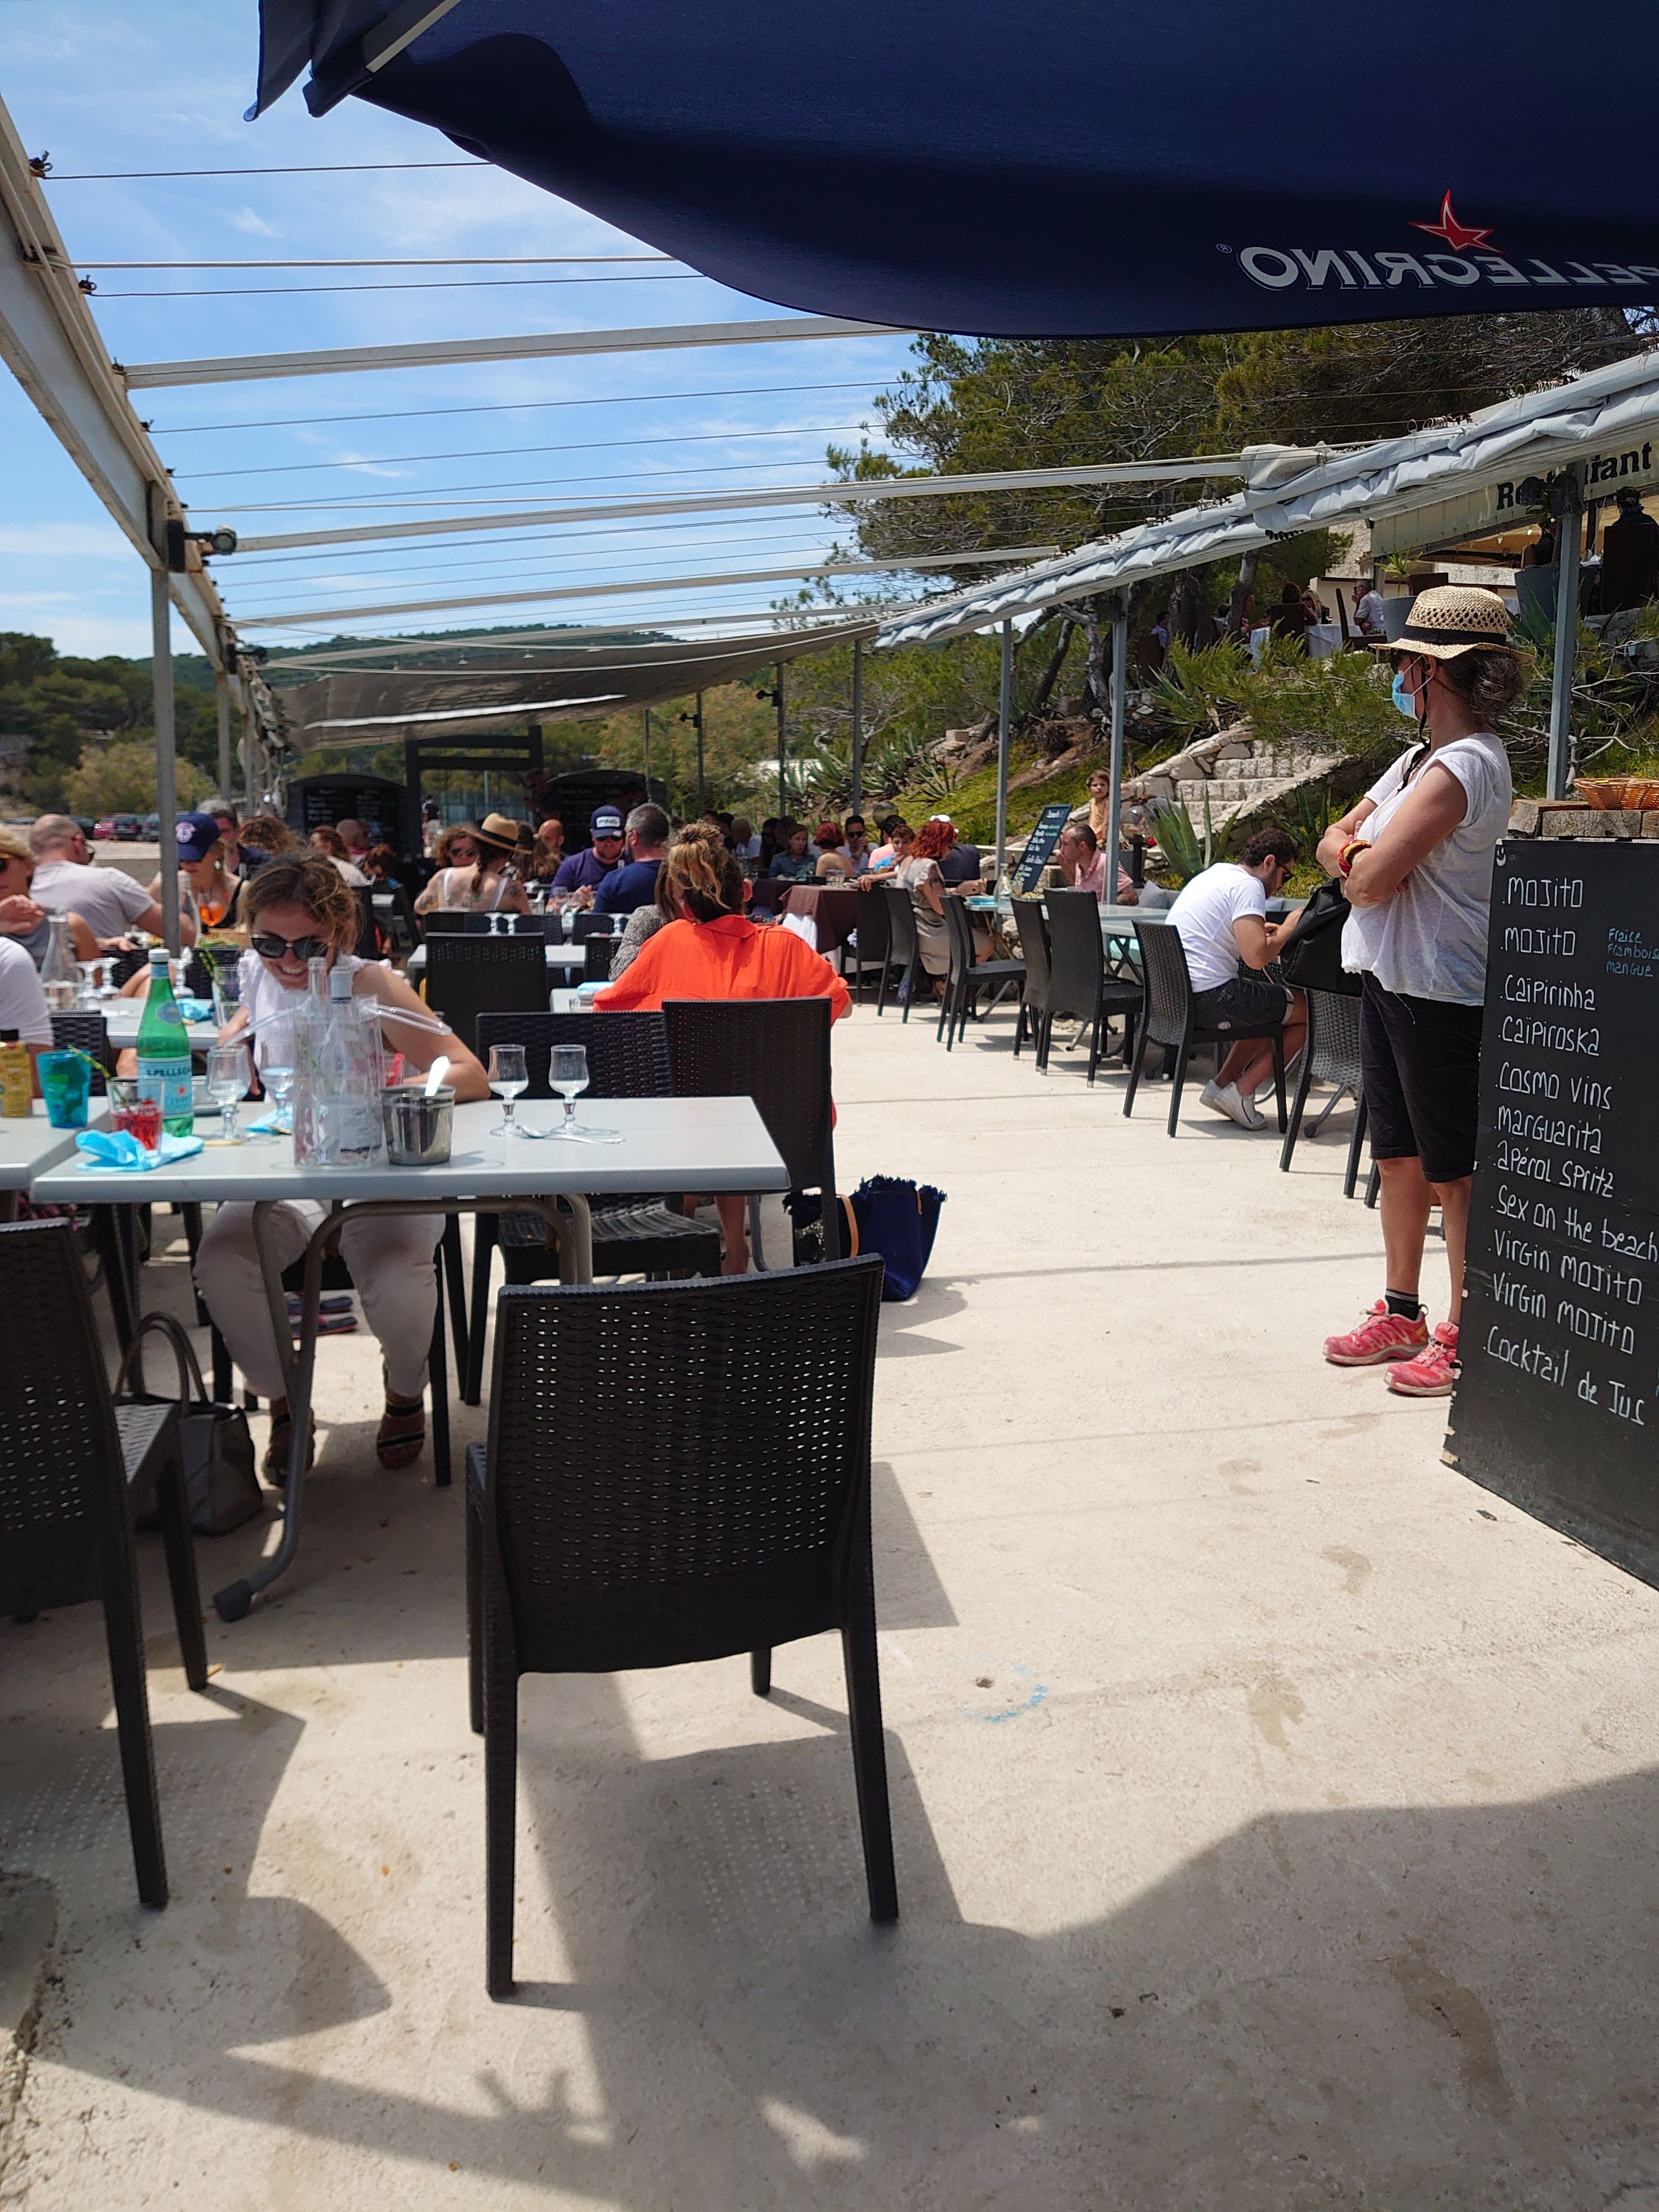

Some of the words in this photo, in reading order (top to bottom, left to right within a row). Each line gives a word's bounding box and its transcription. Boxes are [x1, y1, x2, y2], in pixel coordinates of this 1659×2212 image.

[1607, 943, 1659, 960] Frambois
[1496, 1184, 1529, 1221] Sex
[1533, 1204, 1556, 1231] on
[1564, 1207, 1592, 1243] the
[1601, 1218, 1658, 1262] beach
[1487, 1325, 1569, 1386] Cocktail
[1577, 1371, 1598, 1405] de
